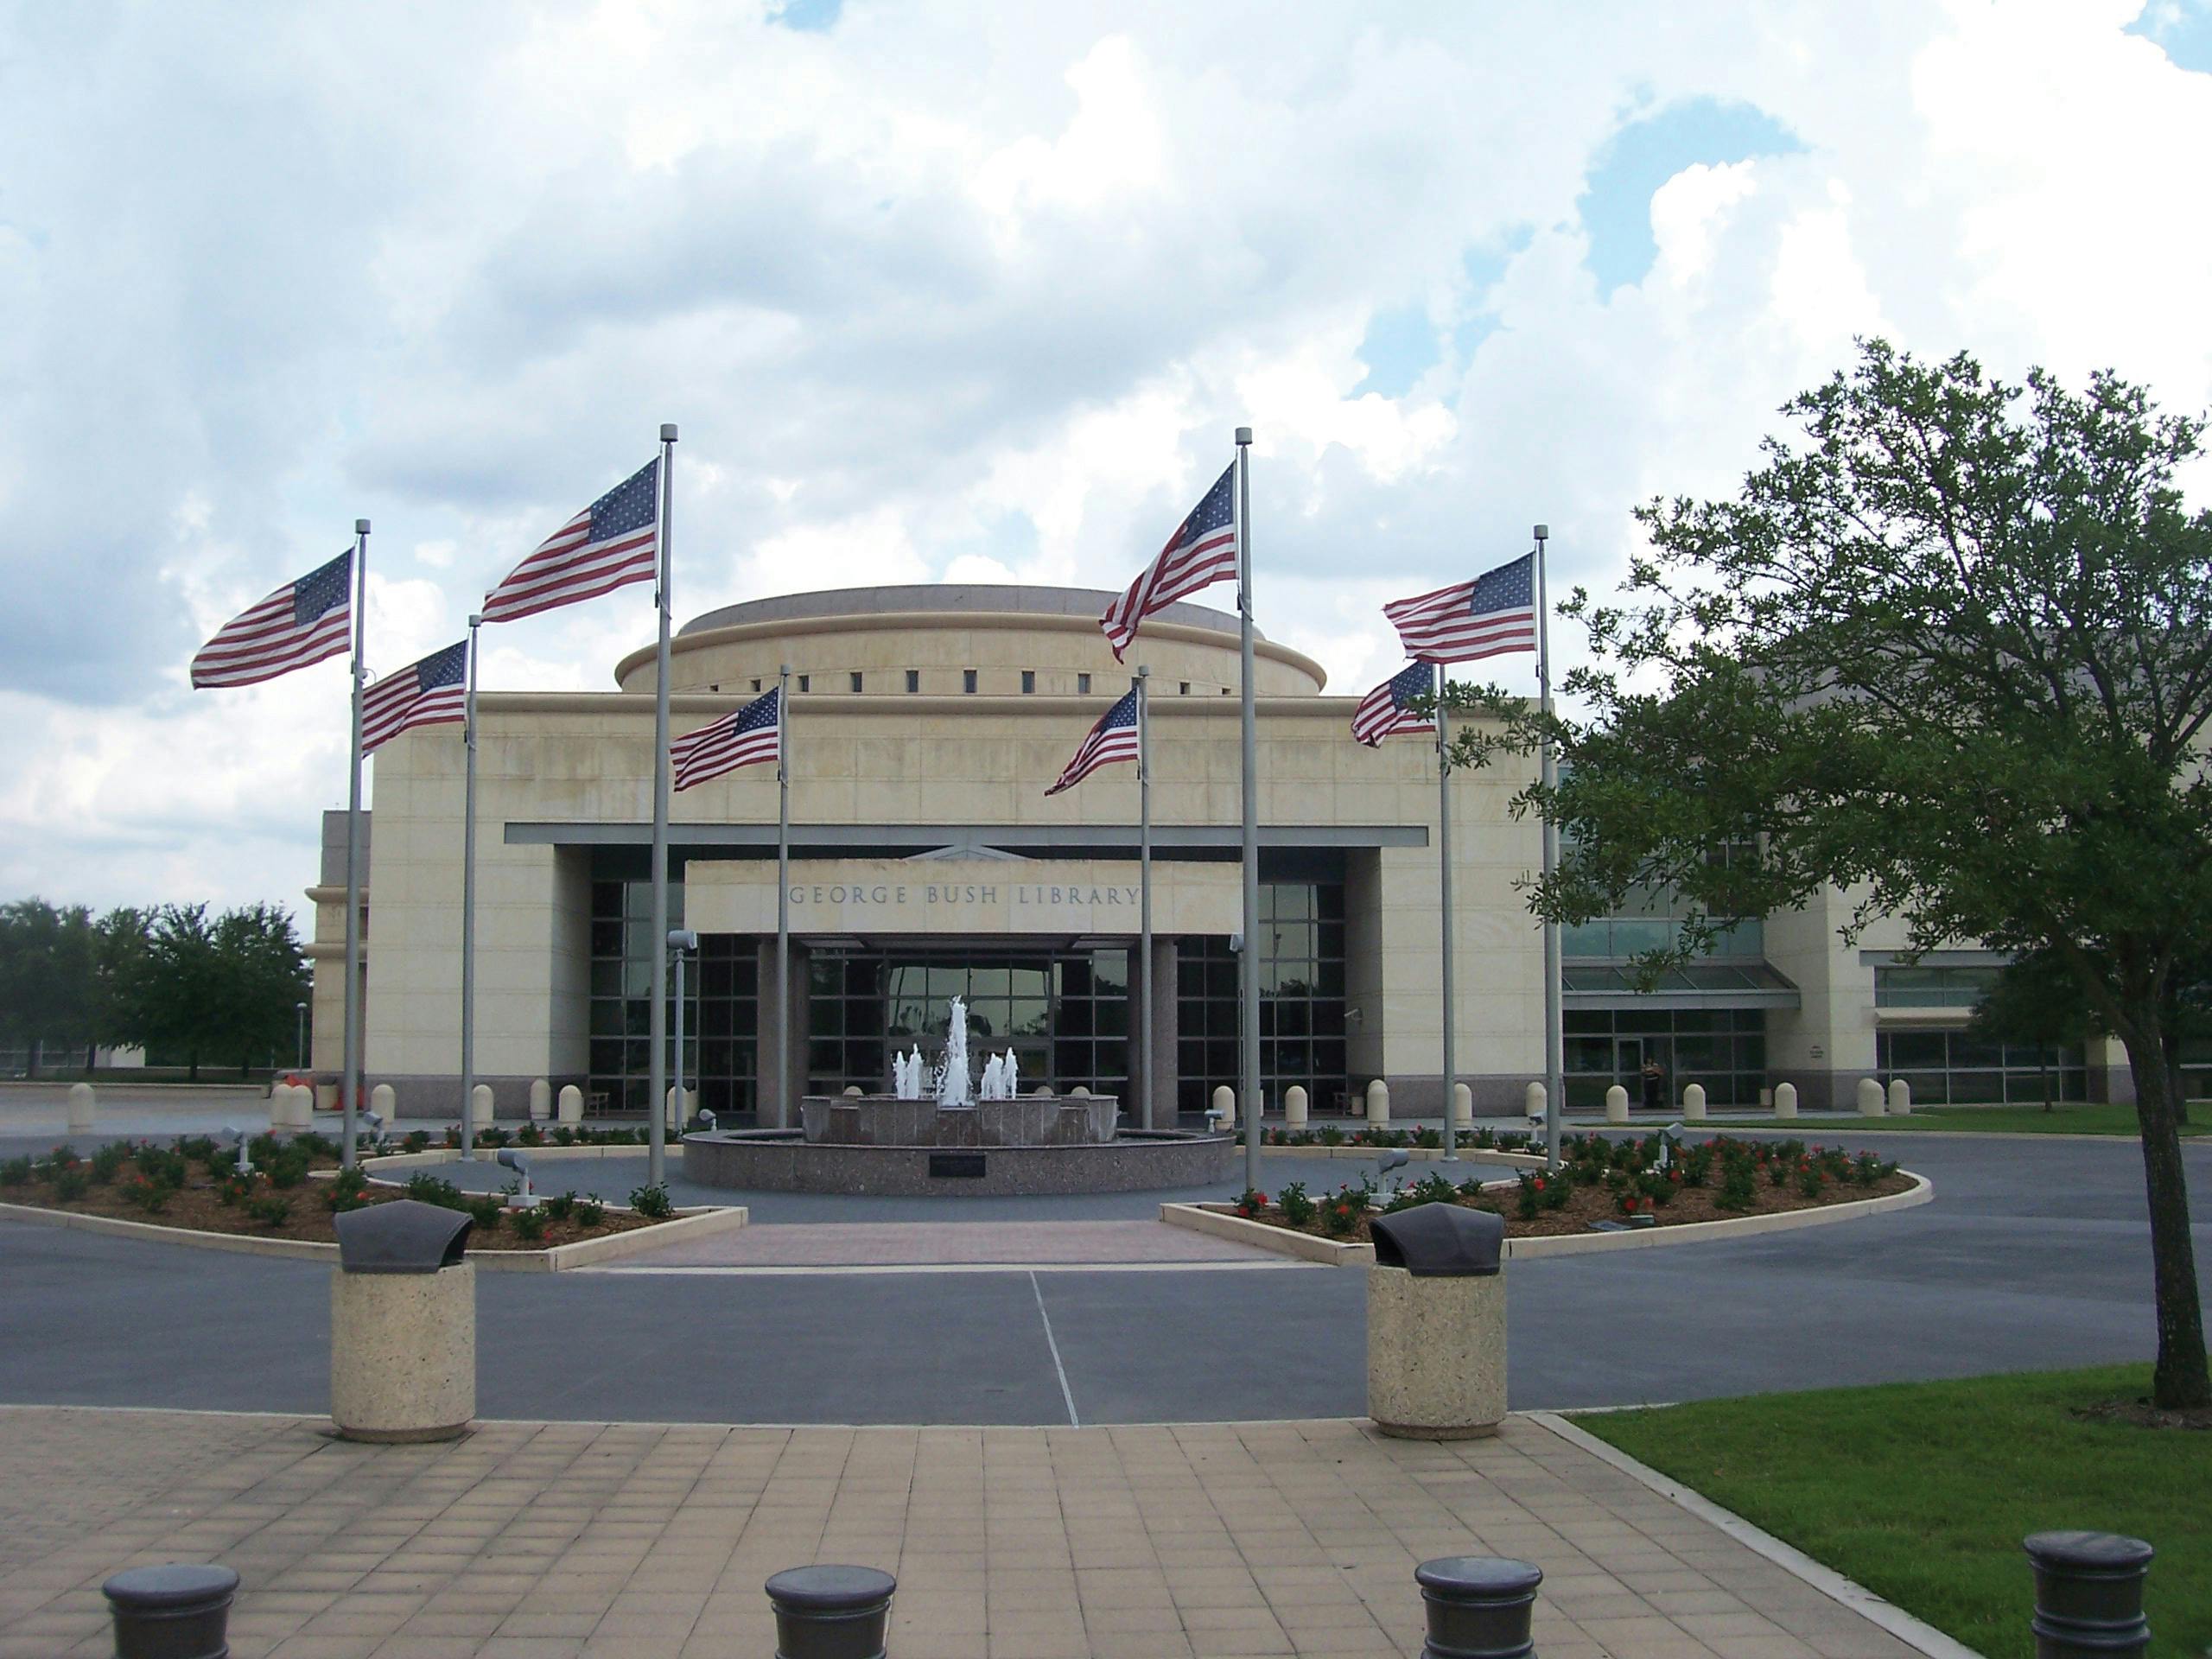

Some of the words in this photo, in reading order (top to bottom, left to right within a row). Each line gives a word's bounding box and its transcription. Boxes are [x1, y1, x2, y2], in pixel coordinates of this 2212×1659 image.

[790, 886, 906, 904] GEORGE
[927, 886, 997, 904] BUSH
[1019, 887, 1140, 905] LIBRARY
